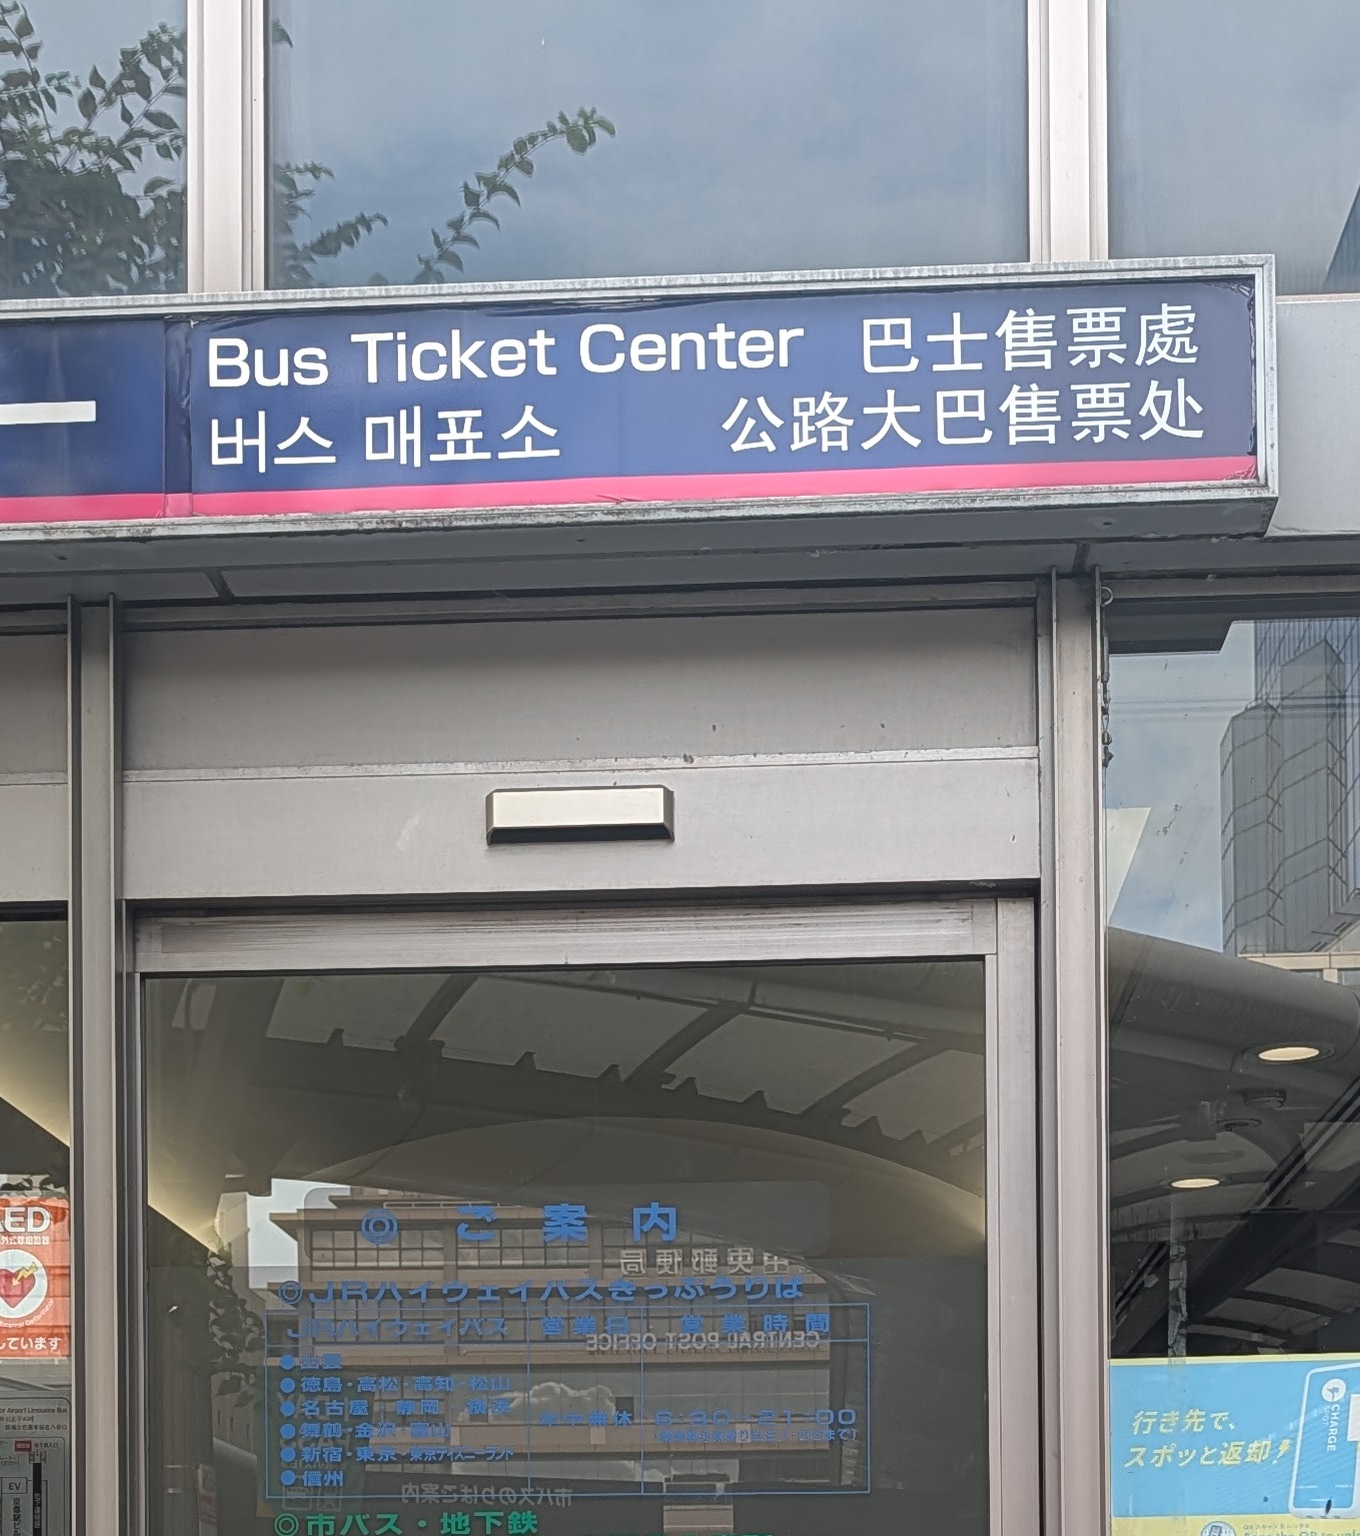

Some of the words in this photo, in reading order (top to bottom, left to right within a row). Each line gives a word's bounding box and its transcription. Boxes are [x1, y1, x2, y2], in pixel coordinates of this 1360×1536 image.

[209, 338, 328, 389] Bus
[352, 328, 557, 384] Ticket
[580, 321, 805, 374] Center
[861, 302, 1200, 375] 巴士售票處
[722, 378, 1205, 455] 公路大巴售票处
[209, 416, 337, 475] 버스
[364, 404, 561, 469] 매표소
[308, 1275, 805, 1304] JRハイウェイバスきっぷうりば
[286, 1316, 509, 1339] JRハイウェイバス
[541, 1315, 630, 1337] 営業日
[680, 1312, 831, 1335] 営業時間
[1131, 1408, 1236, 1436] 行き先で、
[1326, 1403, 1341, 1452] CHARGE
[8, 1482, 22, 1491] EV
[301, 1470, 344, 1487] 信州
